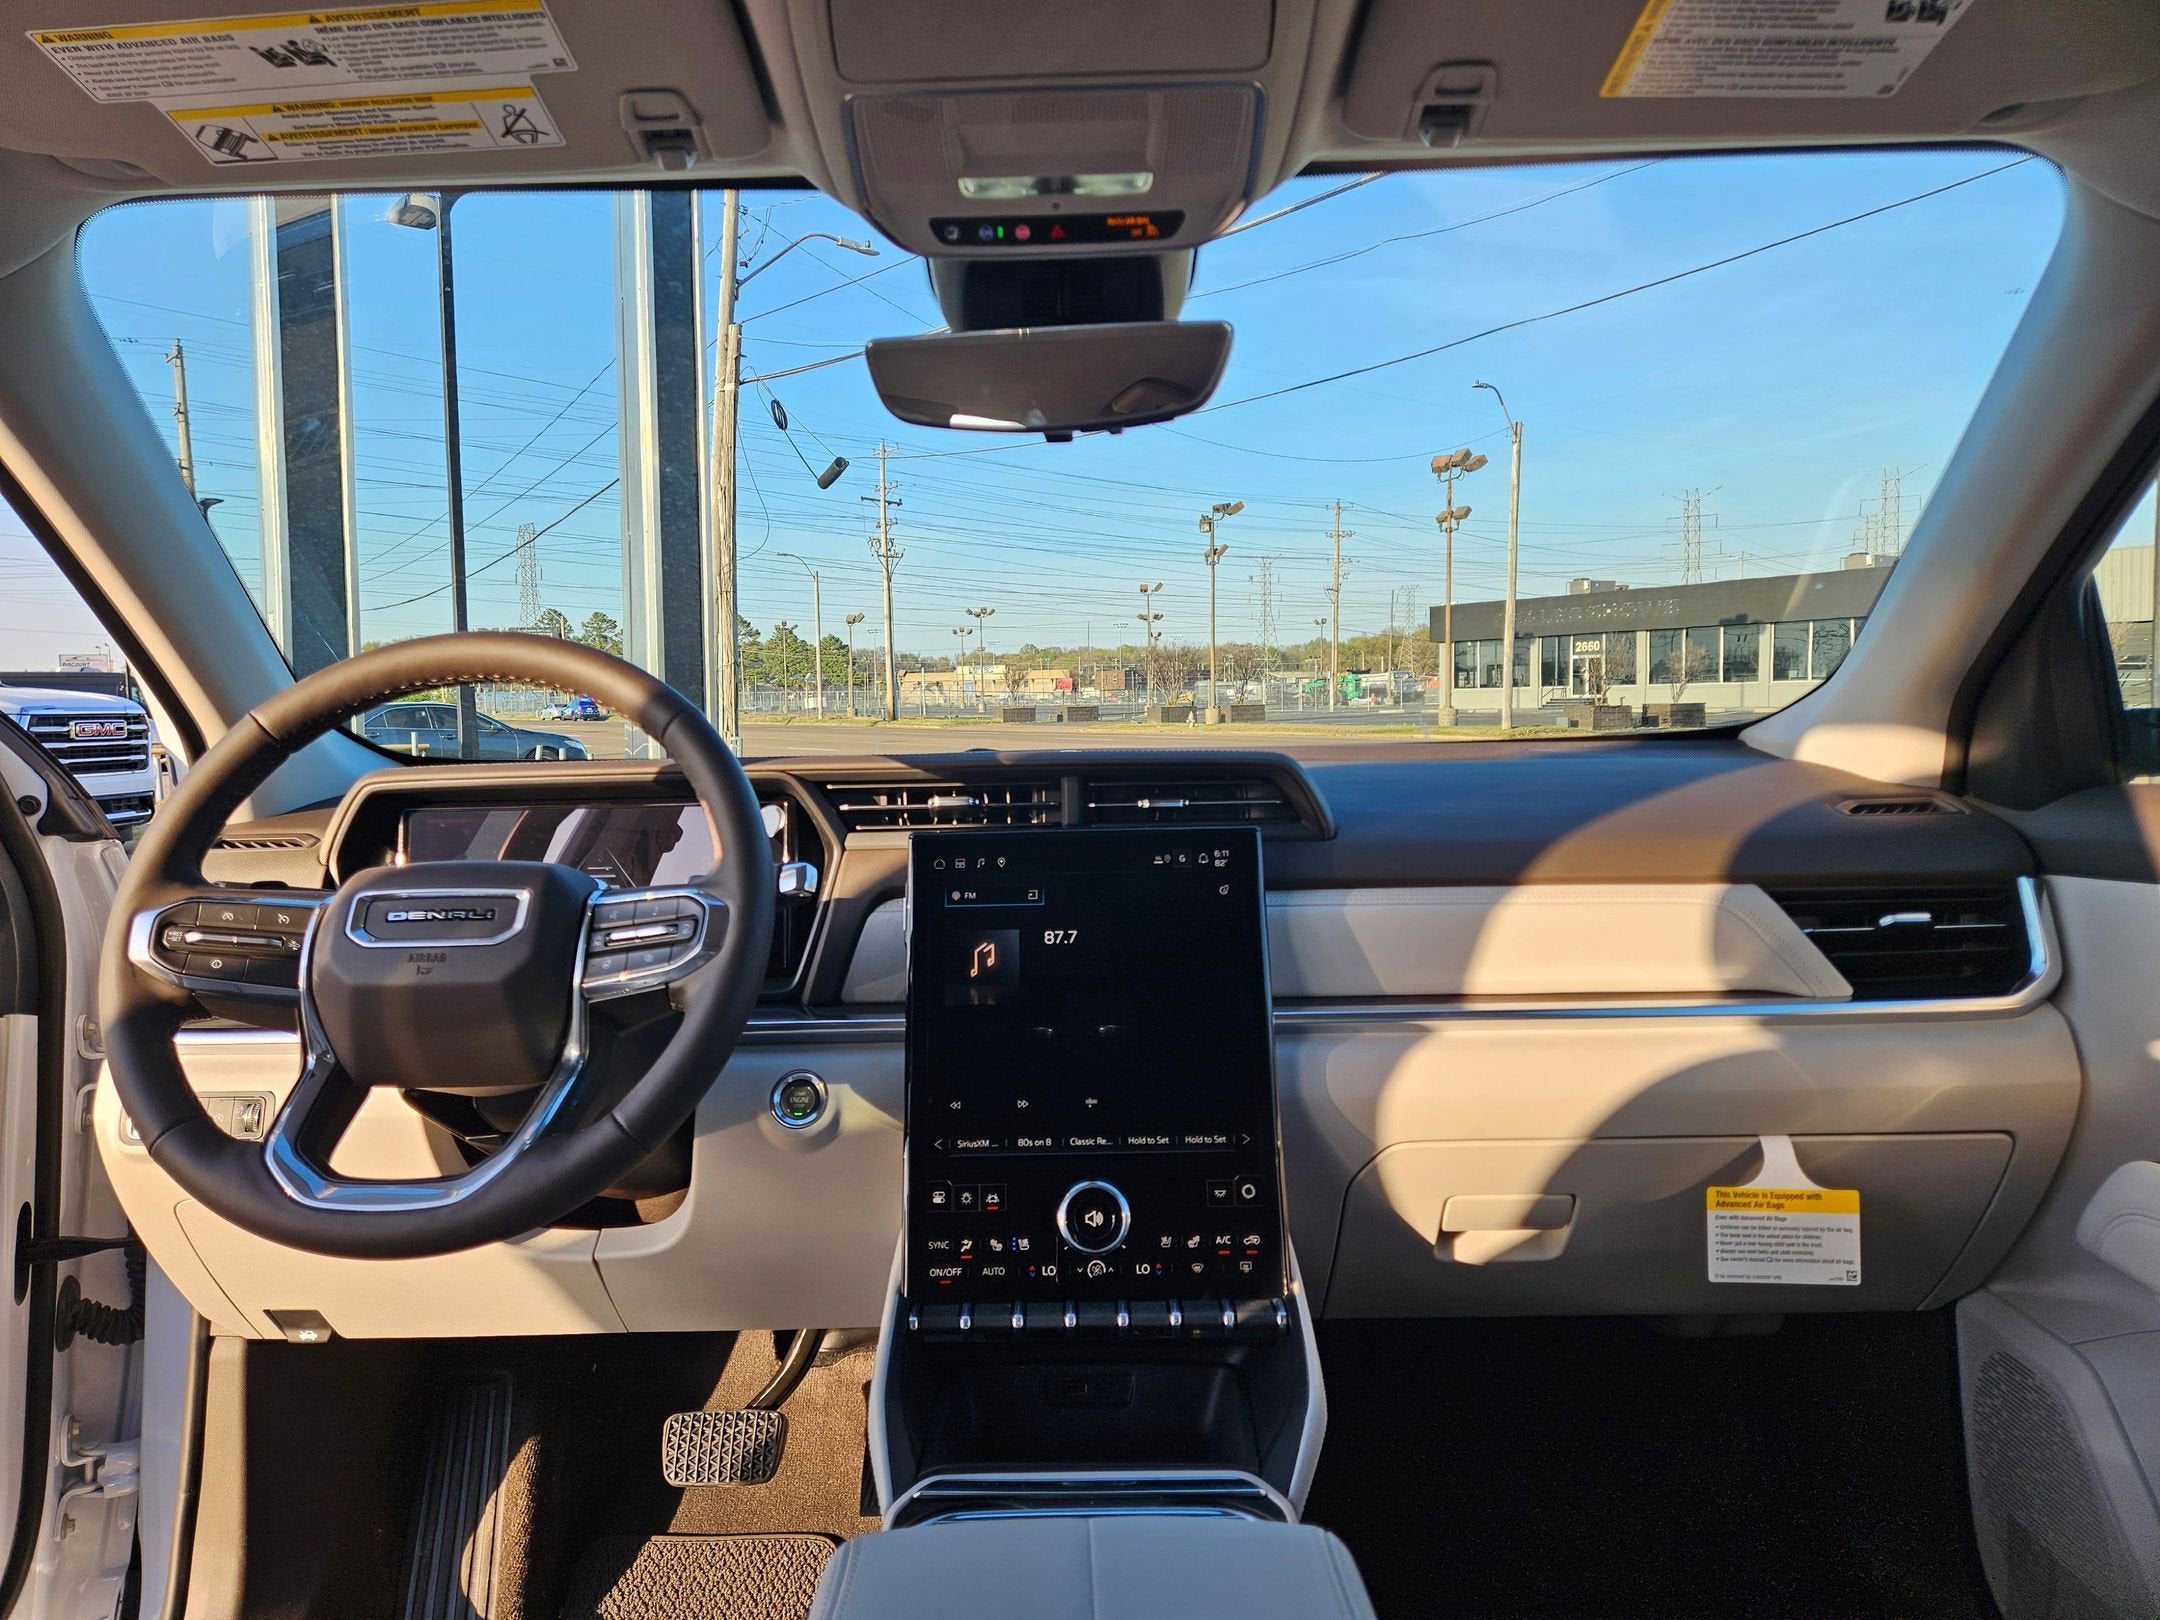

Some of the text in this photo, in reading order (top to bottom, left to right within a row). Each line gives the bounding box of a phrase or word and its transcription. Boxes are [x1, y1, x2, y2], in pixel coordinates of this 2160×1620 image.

[54, 31, 114, 42] WARNING
[51, 33, 235, 54] EVEN WITH ADVANCED AIR BAGS
[1575, 641, 1601, 653] 2660
[76, 722, 126, 737] GMC
[386, 908, 497, 922] DENALI
[1043, 930, 1078, 944] 87.7
[408, 953, 447, 963] AIRBAG
[957, 1138, 990, 1148] SiriusXM
[1017, 1138, 1033, 1147] 80s
[1069, 1137, 1095, 1146] Classic
[1128, 1136, 1170, 1145] Hold to Set
[1185, 1135, 1227, 1144] Hold to Set
[1715, 1190, 1730, 1199] This
[1733, 1191, 1760, 1199] Vehicle
[1770, 1192, 1804, 1201] Equipped
[1806, 1192, 1823, 1200] with
[1715, 1200, 1752, 1208] Advanced
[1766, 1201, 1785, 1210] Bags
[1215, 1235, 1232, 1245] A/C
[928, 1241, 950, 1250] SYNC
[929, 1267, 962, 1277] ON/OFF
[982, 1267, 1006, 1276] AUTO
[1042, 1265, 1057, 1276] LO
[1136, 1263, 1151, 1275] LO
